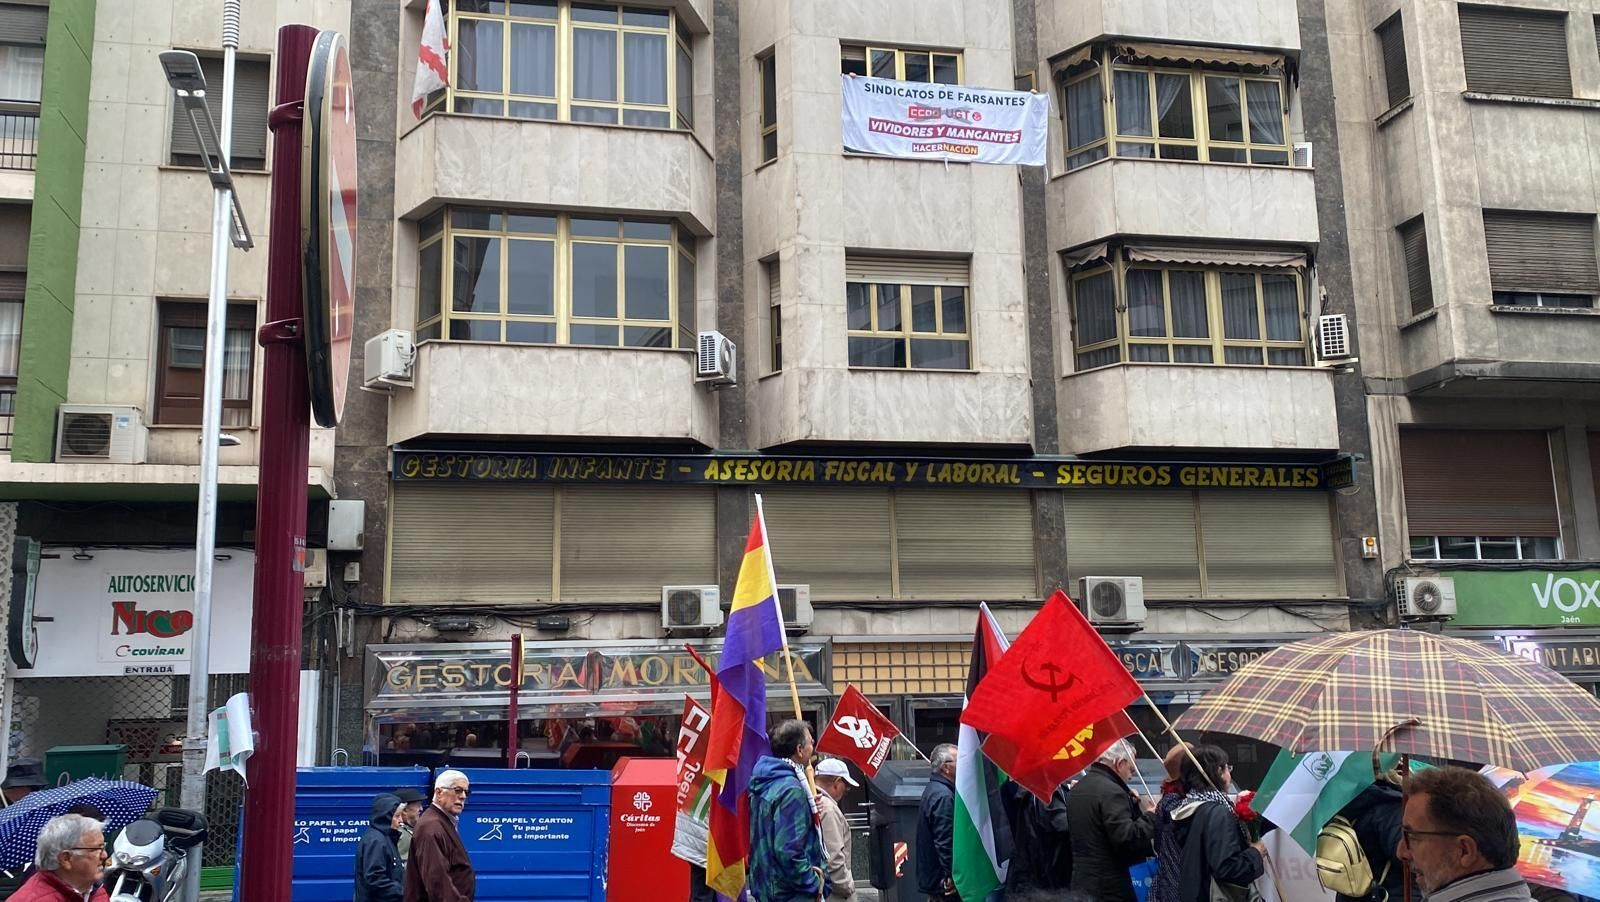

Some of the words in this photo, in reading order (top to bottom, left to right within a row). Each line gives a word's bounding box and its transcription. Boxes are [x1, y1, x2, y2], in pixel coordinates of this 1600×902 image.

[864, 82, 935, 100] SINDICATOS
[938, 90, 954, 100] DE
[958, 92, 1026, 106] FARSANTES
[870, 120, 934, 137] VIVIDORES
[935, 126, 946, 137] Y
[946, 127, 1020, 143] MANGANTES
[913, 144, 977, 154] HACERNACIÓN
[400, 455, 537, 479] GESTORIA
[547, 457, 667, 480] INFANTE
[704, 458, 816, 481] ASESORIA
[825, 460, 896, 482] FISCAL
[905, 462, 918, 482] Y
[926, 462, 1021, 484] LABORAL
[1056, 465, 1172, 486] SEGUROS
[1179, 466, 1319, 488] GENERALES
[1532, 573, 1600, 613] VOX
[1560, 616, 1581, 624] Jaén
[125, 666, 174, 675] ENTRADA
[386, 662, 579, 689] GESTORIA
[608, 655, 815, 687] MORINA
[620, 814, 661, 822] Cáritas
[525, 824, 548, 832] papel
